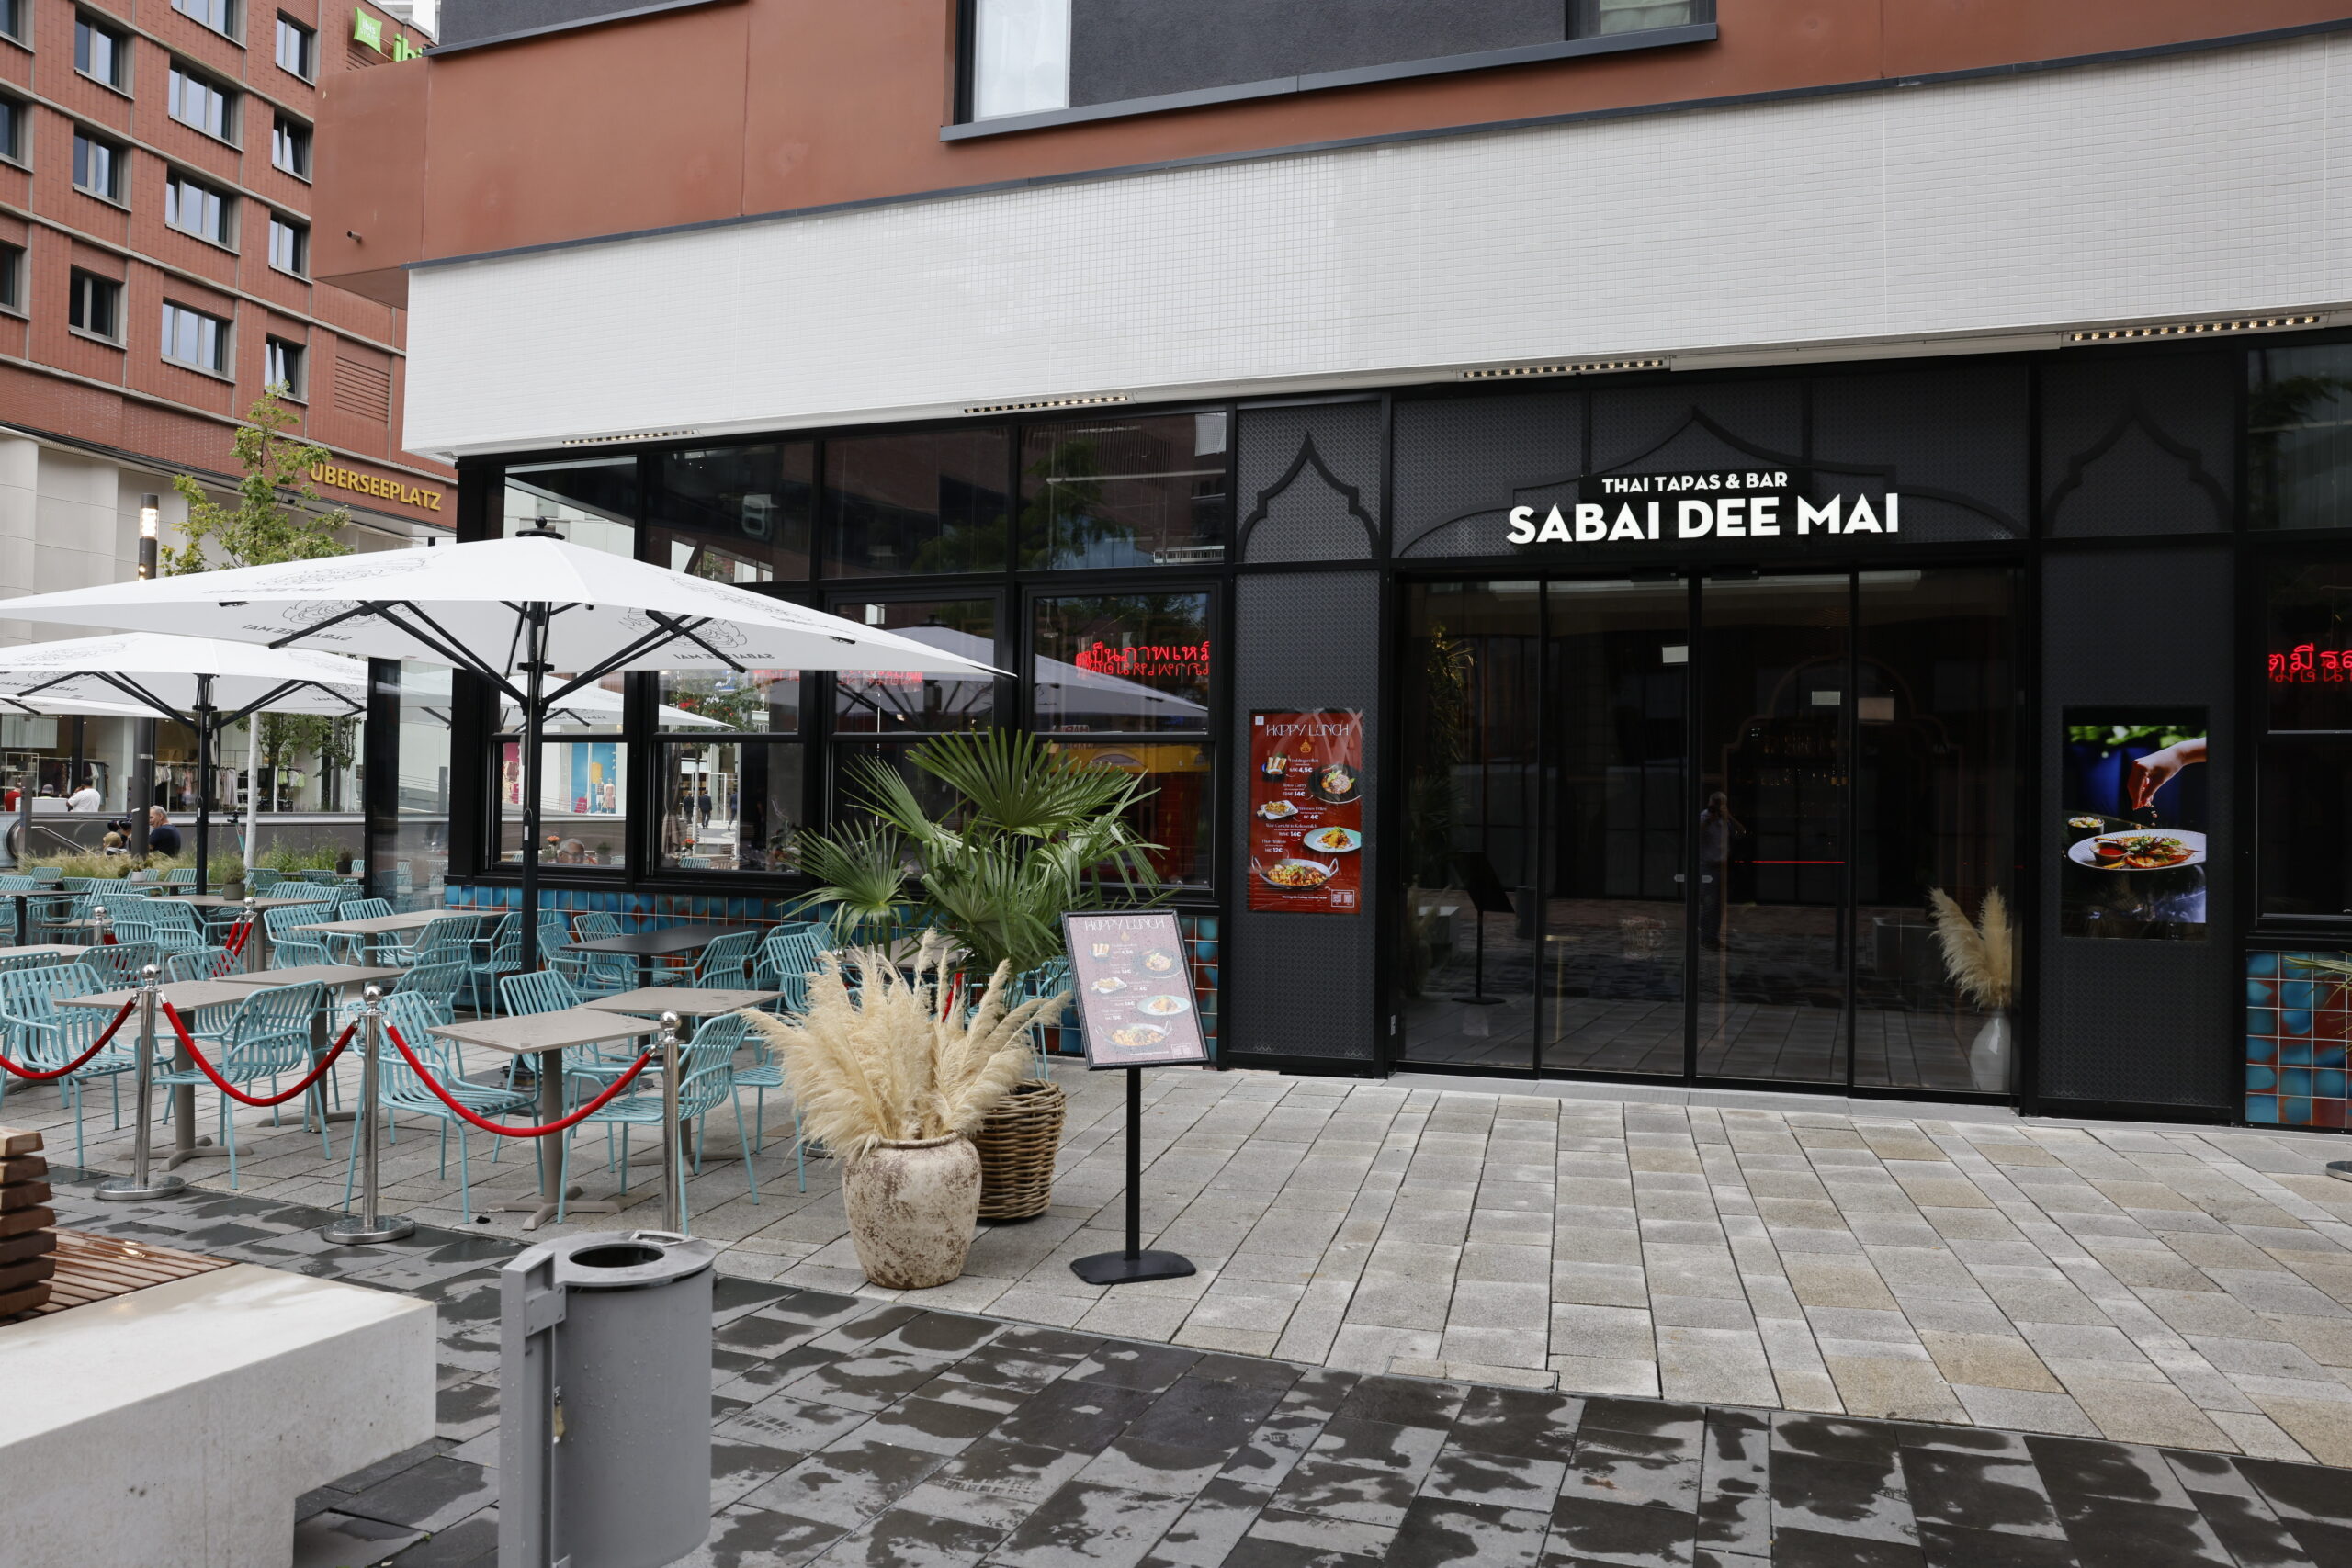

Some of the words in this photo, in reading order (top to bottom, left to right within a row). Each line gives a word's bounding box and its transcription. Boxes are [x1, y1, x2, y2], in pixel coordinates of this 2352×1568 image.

[1601, 477, 1649, 493] THAI
[1654, 474, 1721, 491] TAPAS
[1725, 473, 1741, 489] &
[1746, 471, 1789, 488] BAR
[1506, 501, 1660, 545] SABAI
[1678, 496, 1781, 539] DEE
[1797, 492, 1899, 535] MAI
[1266, 724, 1306, 736] HAPPY
[1308, 723, 1350, 736] LUNCH
[1084, 919, 1123, 931] HAPPY
[1126, 918, 1165, 930] LUNCH
